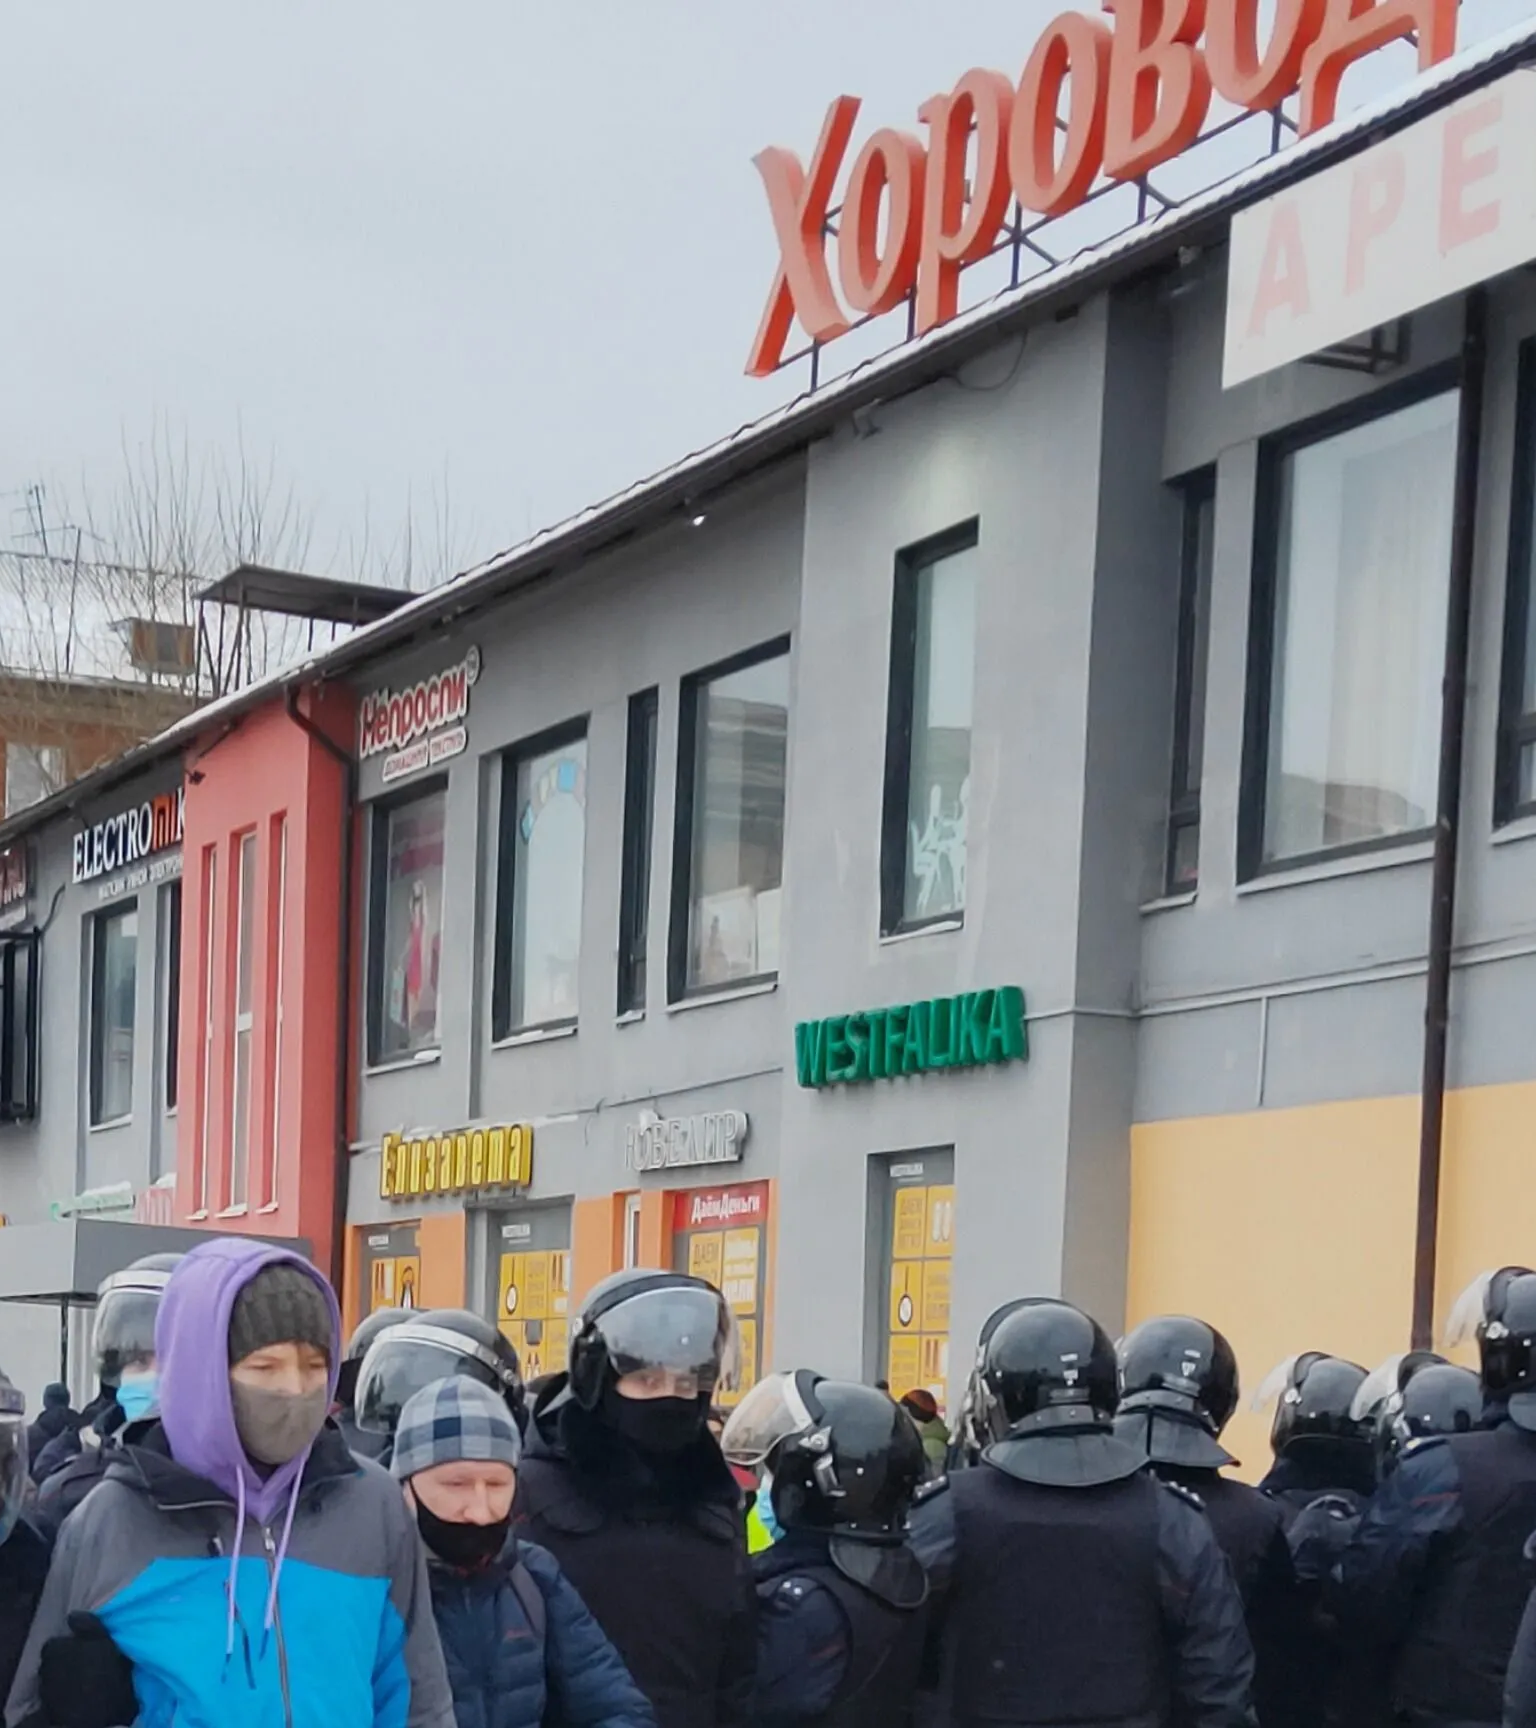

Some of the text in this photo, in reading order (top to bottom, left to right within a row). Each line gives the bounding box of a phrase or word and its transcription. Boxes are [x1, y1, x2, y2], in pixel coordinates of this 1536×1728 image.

[795, 985, 1026, 1090] WESTFALIKA
[380, 1124, 533, 1200] Елизавета
[625, 1111, 747, 1171] ЮВЕЛИР
